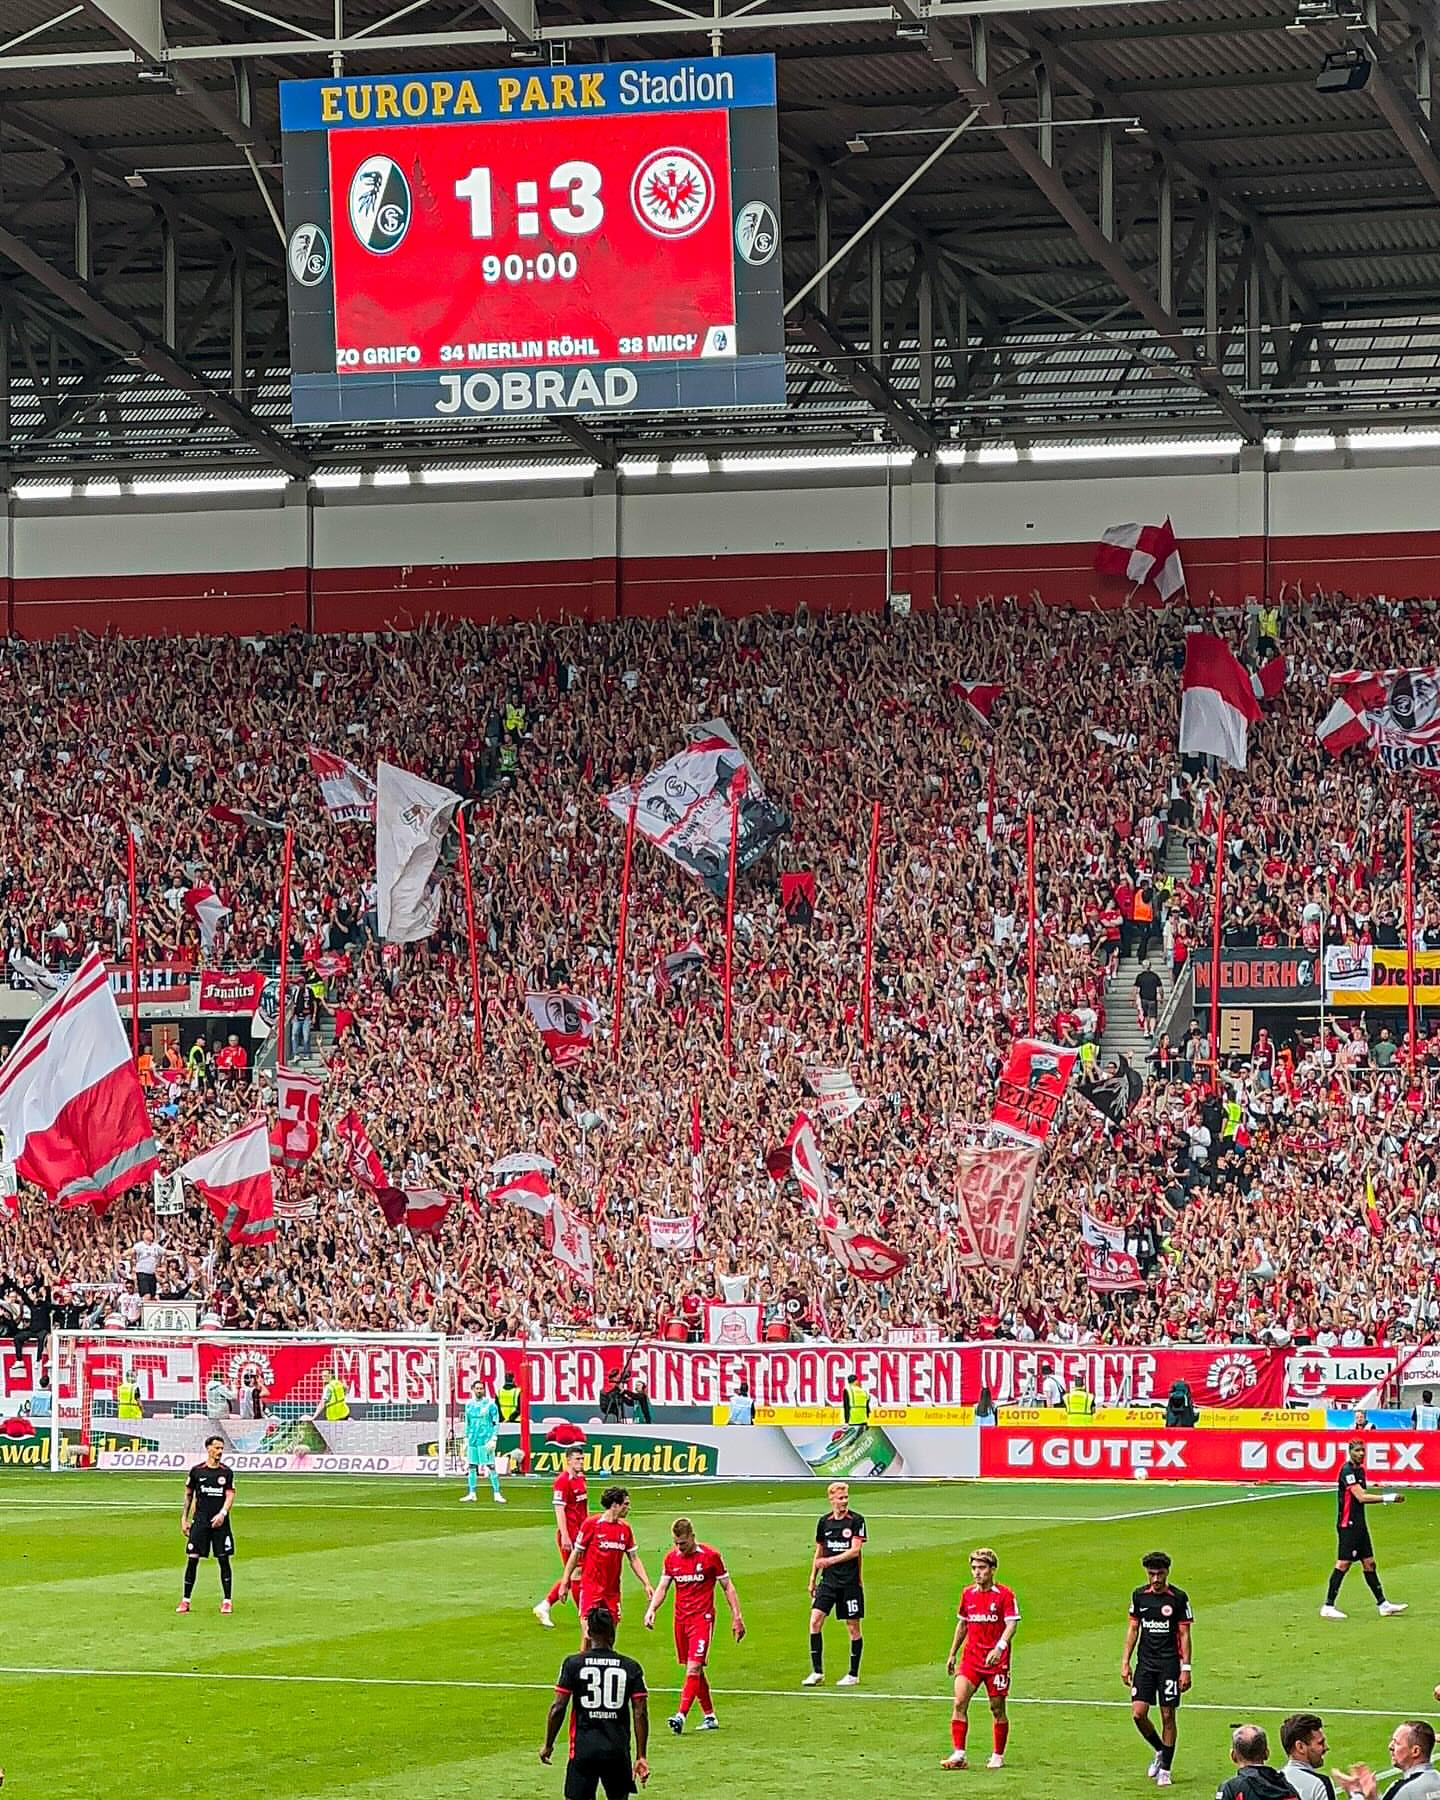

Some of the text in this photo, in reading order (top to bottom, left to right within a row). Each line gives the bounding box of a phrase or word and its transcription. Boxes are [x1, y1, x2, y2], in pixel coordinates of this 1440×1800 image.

[321, 66, 734, 122] EUROPA PARK Stadion
[455, 161, 603, 239] 1:3
[482, 251, 578, 282] 90:00
[363, 346, 421, 364] GRIFO
[440, 345, 464, 361] 34
[468, 340, 543, 360] MERLIN
[547, 335, 600, 356] RÖHL
[618, 337, 643, 354] 38
[435, 367, 638, 414] JOBRAD
[525, 1350, 601, 1404] DER
[1335, 1362, 1392, 1380] Label
[873, 1409, 907, 1419] LOTTO
[1006, 1410, 1040, 1420] LOTTO
[1275, 1412, 1310, 1422] LOTTO
[110, 1454, 186, 1468] JOBRAD
[224, 1455, 288, 1470] OBRAD
[1042, 1439, 1188, 1468] GUTEX
[313, 1457, 389, 1471] JOBRAD
[846, 1600, 859, 1613] 16
[696, 1639, 705, 1653] 3
[580, 1667, 627, 1709] 30
